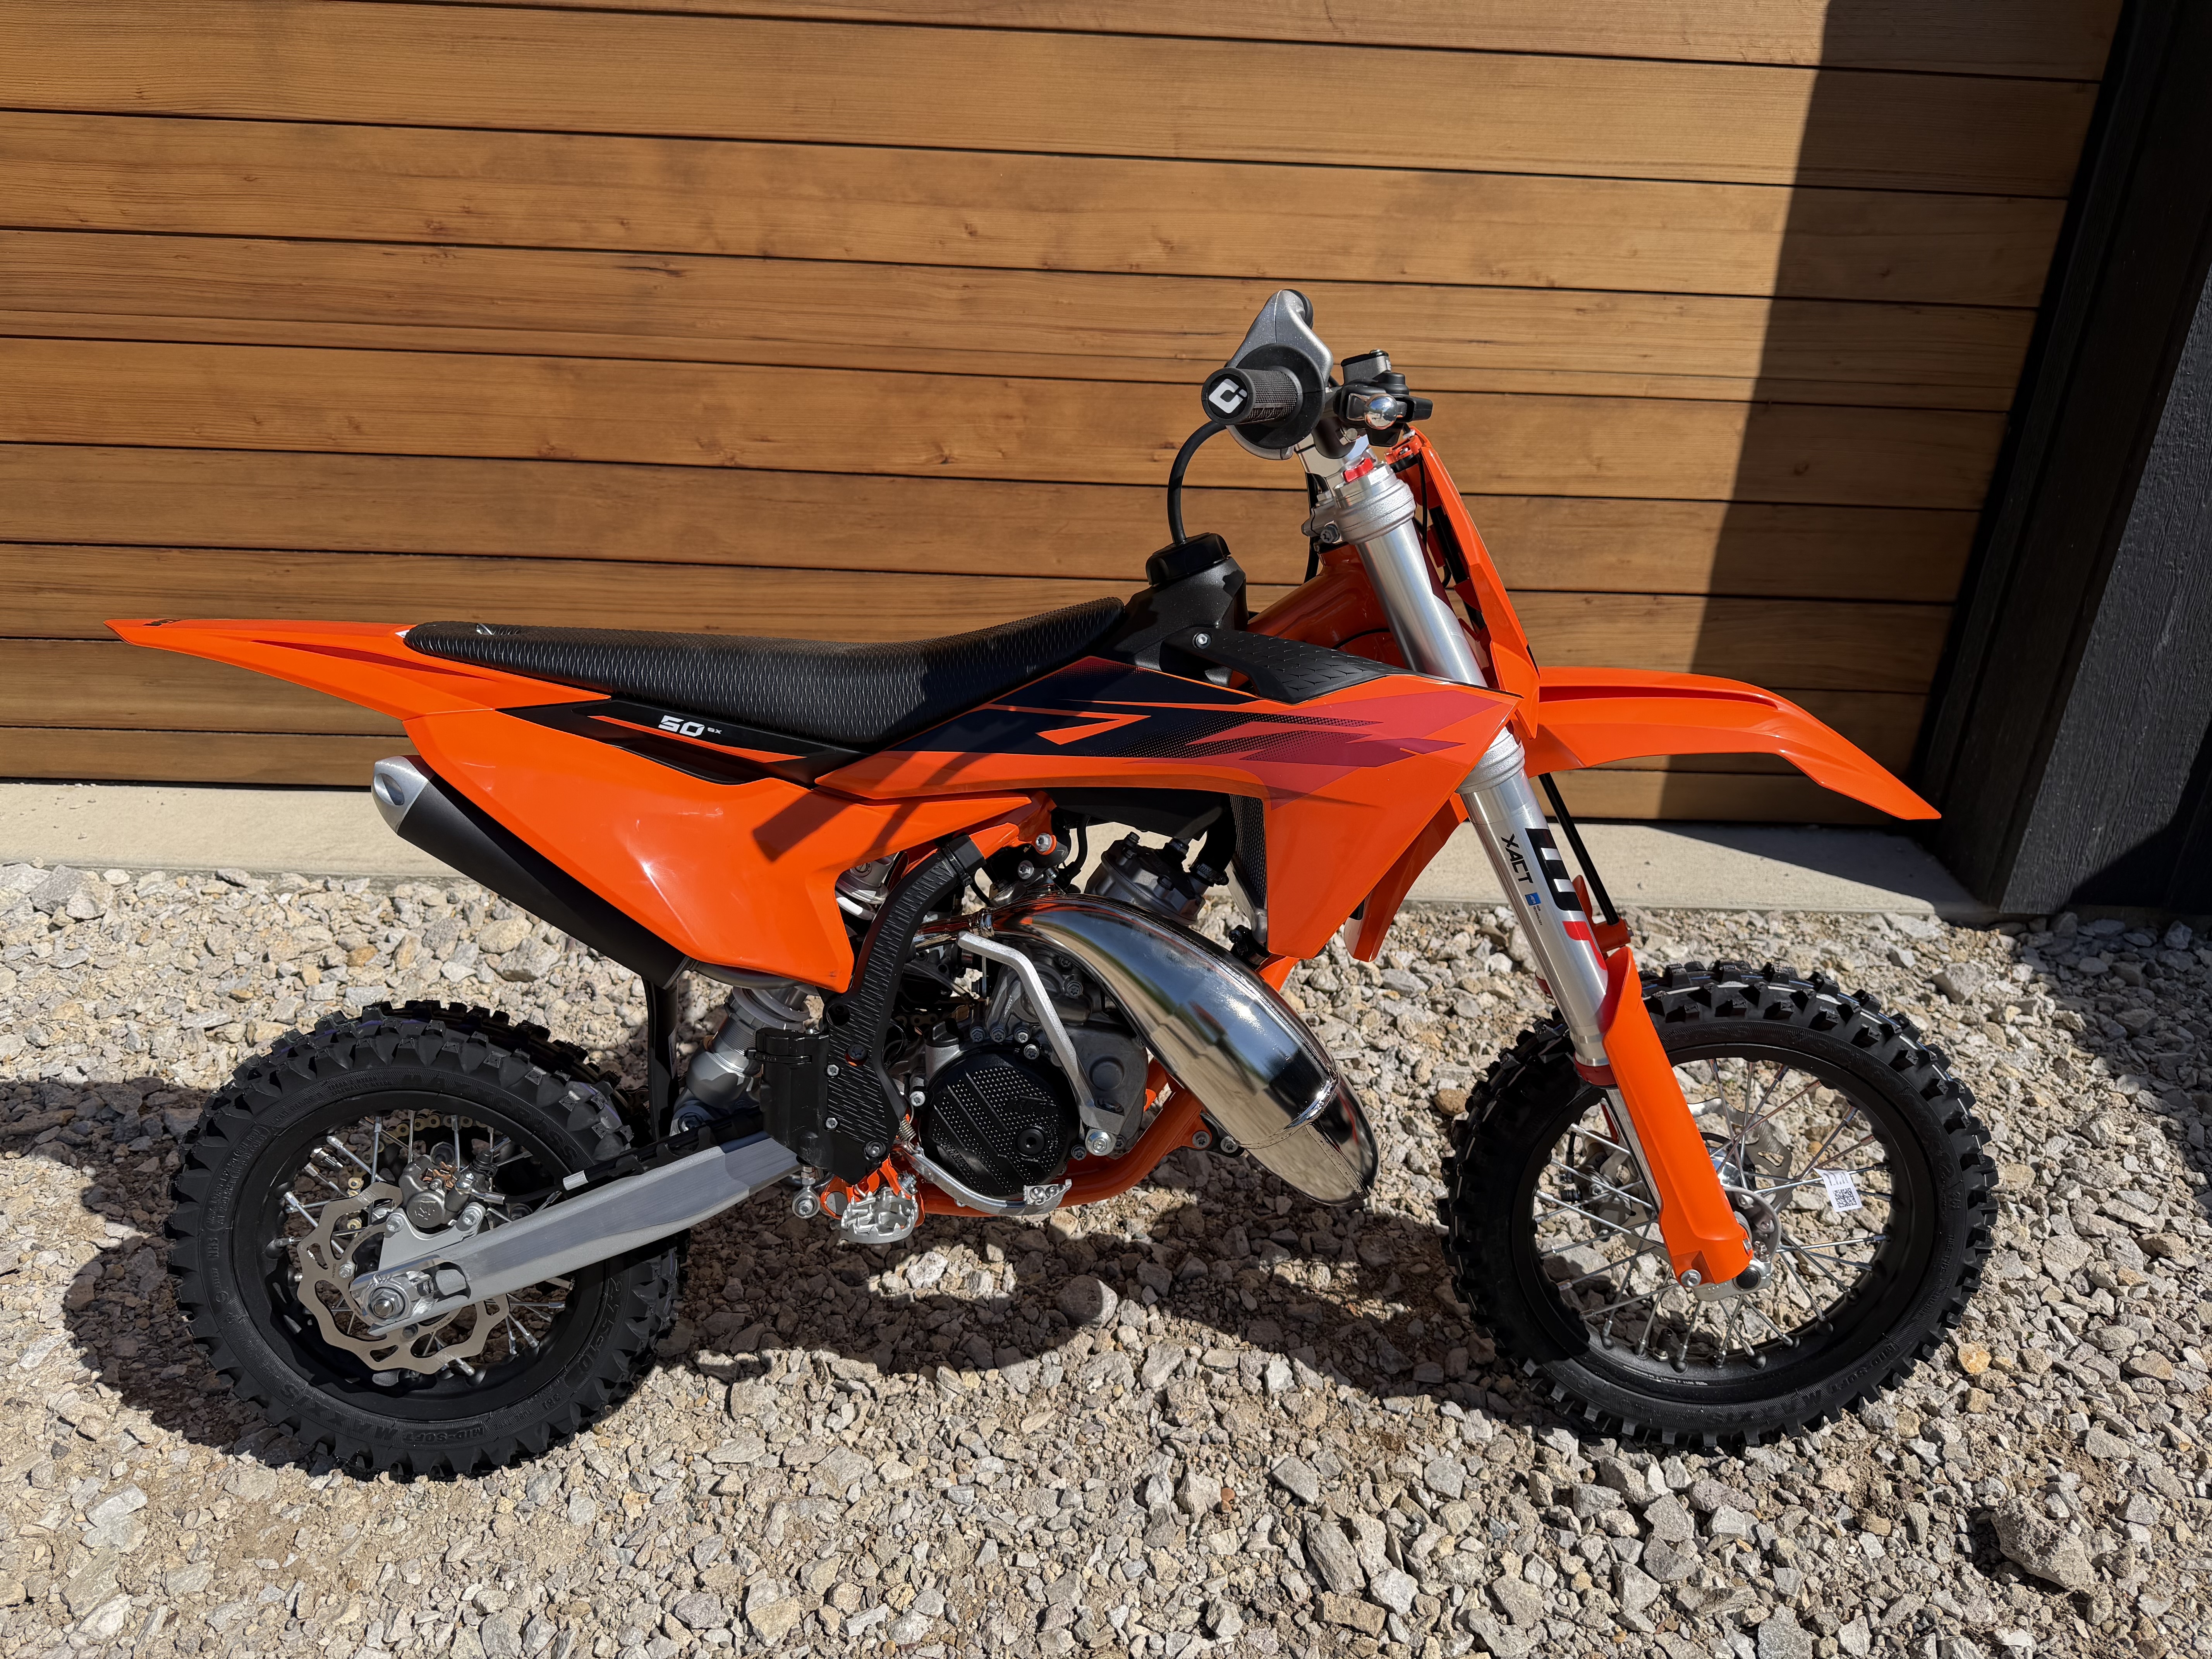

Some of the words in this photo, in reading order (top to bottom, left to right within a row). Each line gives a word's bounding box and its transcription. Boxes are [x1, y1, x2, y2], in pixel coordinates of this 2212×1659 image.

[658, 715, 705, 737] 50
[1501, 833, 1534, 883] XACT
[207, 1237, 219, 1259] NHS
[1944, 1234, 1955, 1252] TUBE
[1938, 1255, 1952, 1273] TYPE
[1828, 1343, 1898, 1395] MID-SOFT
[278, 1381, 398, 1441] MAXXIS
[403, 1425, 485, 1443] MID-SOFT
